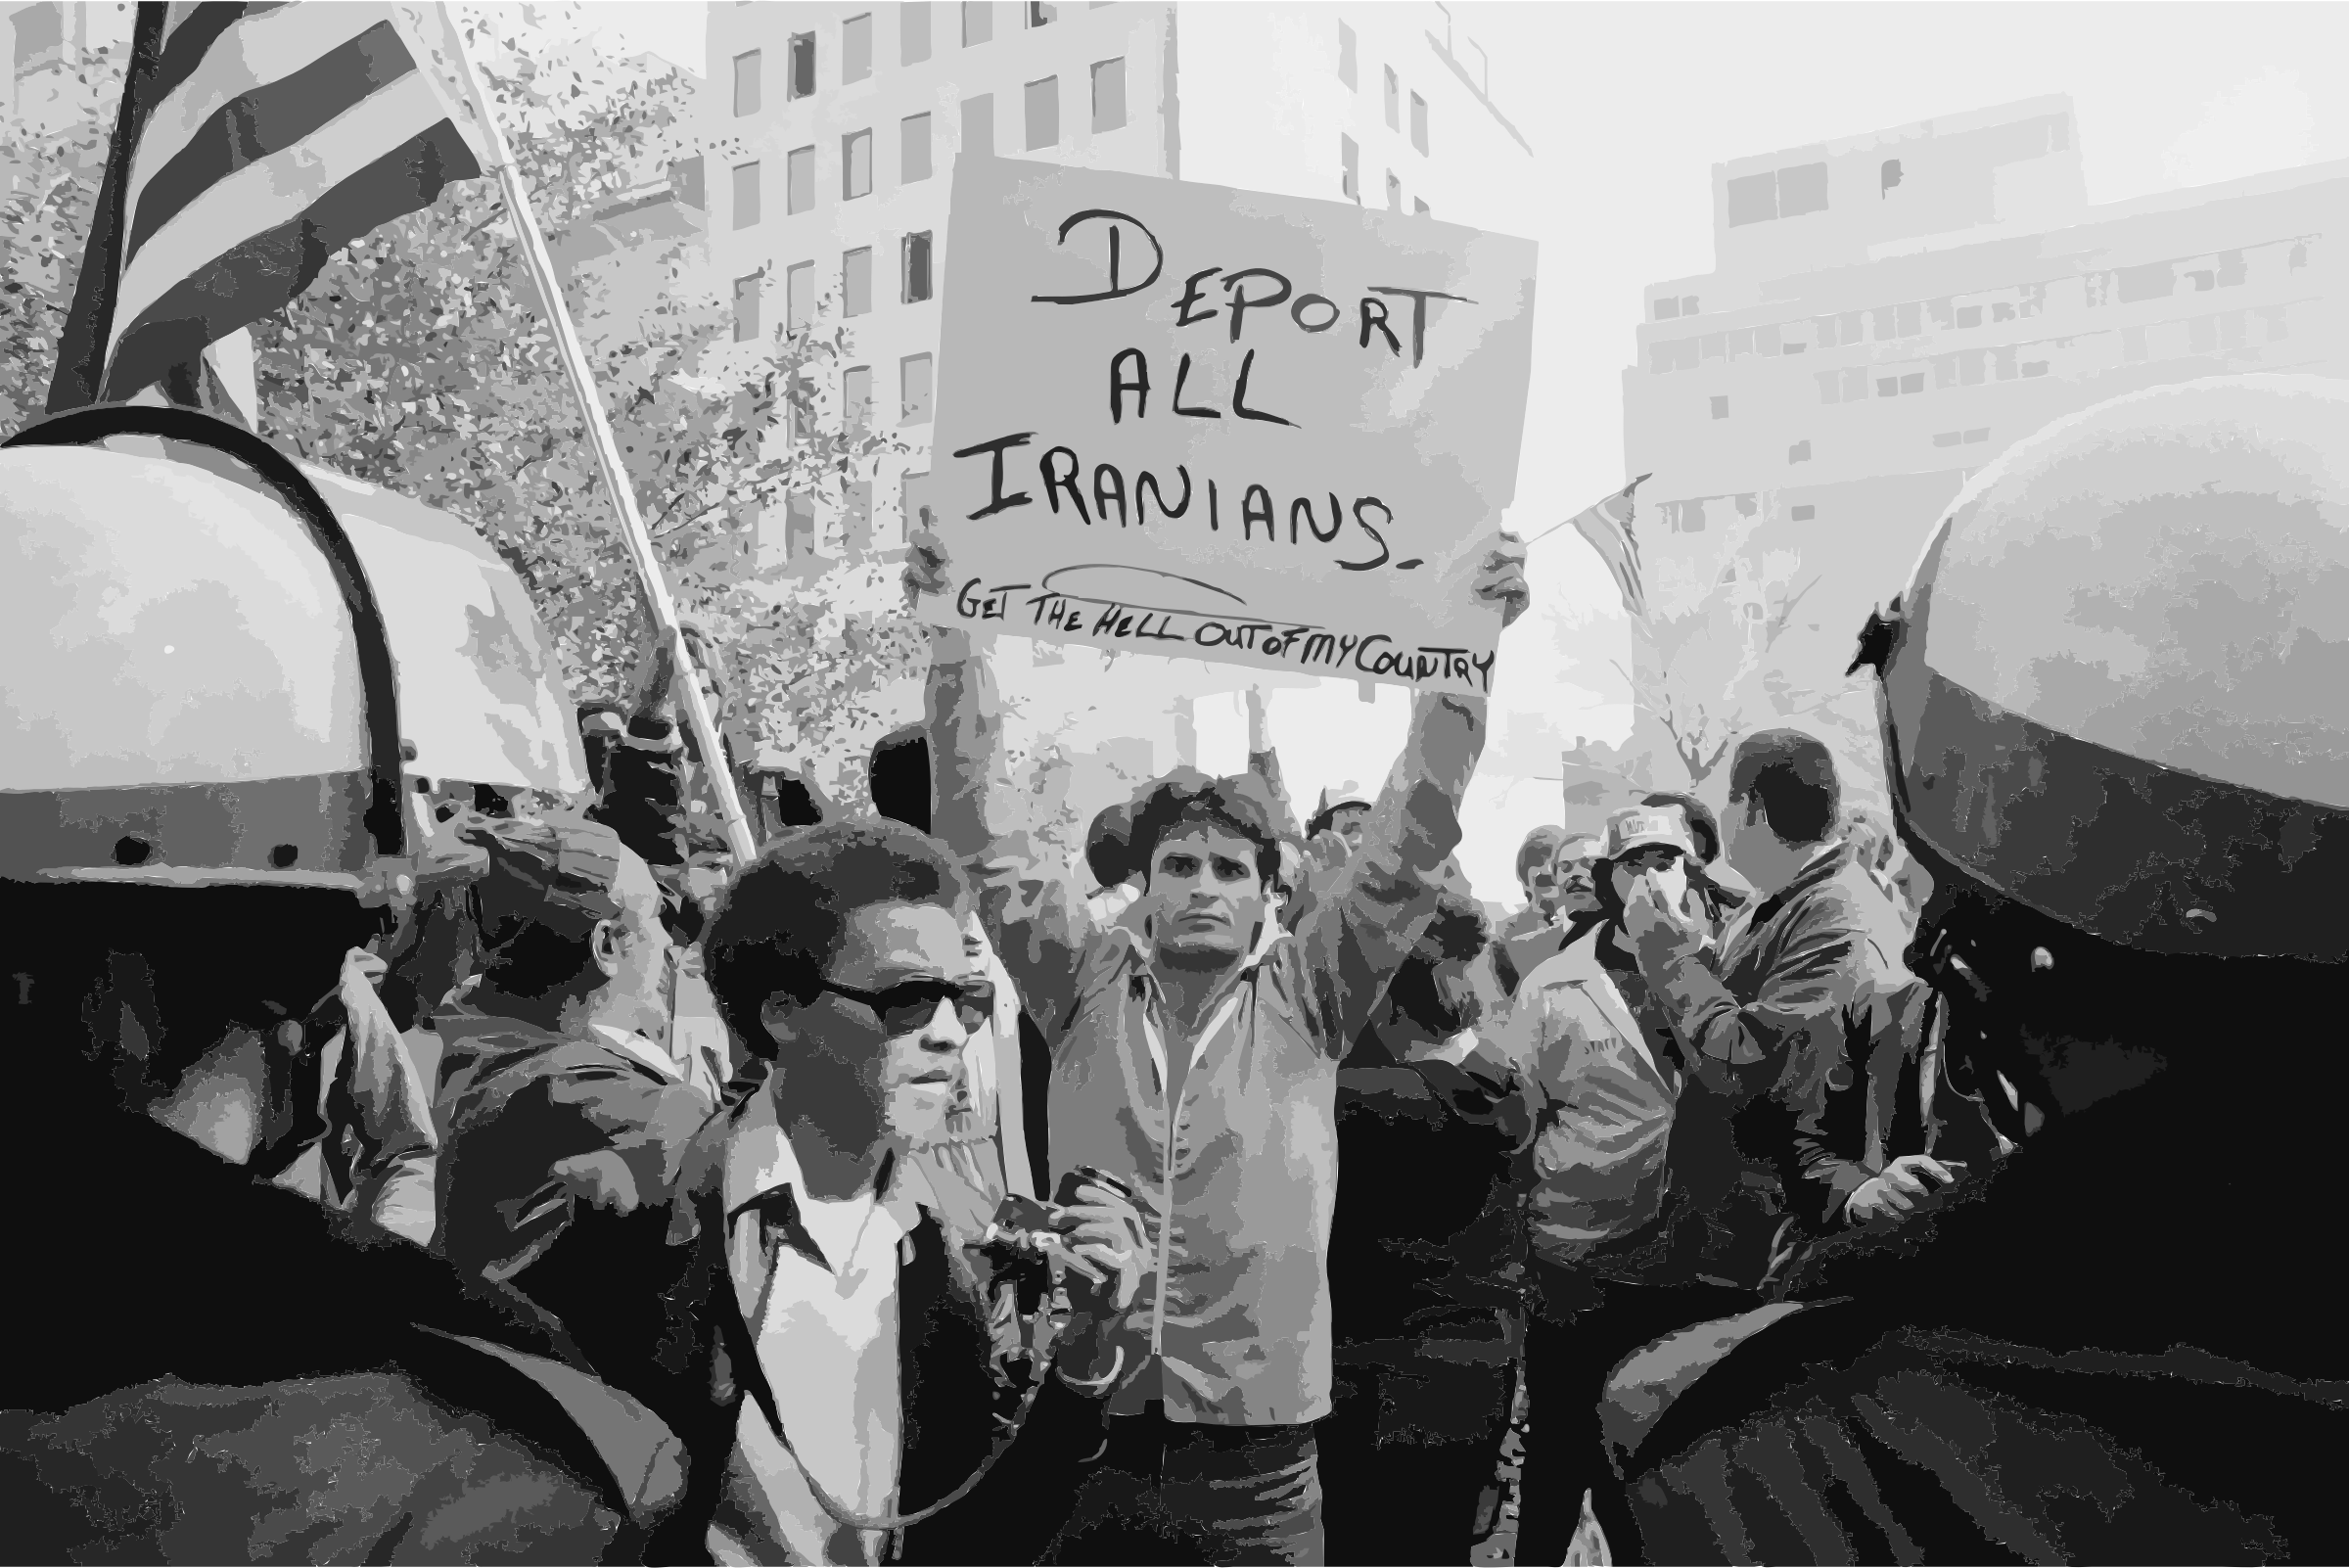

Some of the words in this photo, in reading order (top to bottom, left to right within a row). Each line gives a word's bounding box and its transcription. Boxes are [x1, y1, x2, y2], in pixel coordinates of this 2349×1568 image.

[1031, 208, 1479, 369] DEPORT
[1109, 346, 1303, 430] ALL
[955, 576, 1031, 622] GET
[1025, 591, 1083, 632] THE
[1091, 601, 1186, 642] HELL
[1194, 621, 1273, 651] OUT
[1300, 632, 1359, 669] MY
[1355, 633, 1496, 694] COUNTRY
